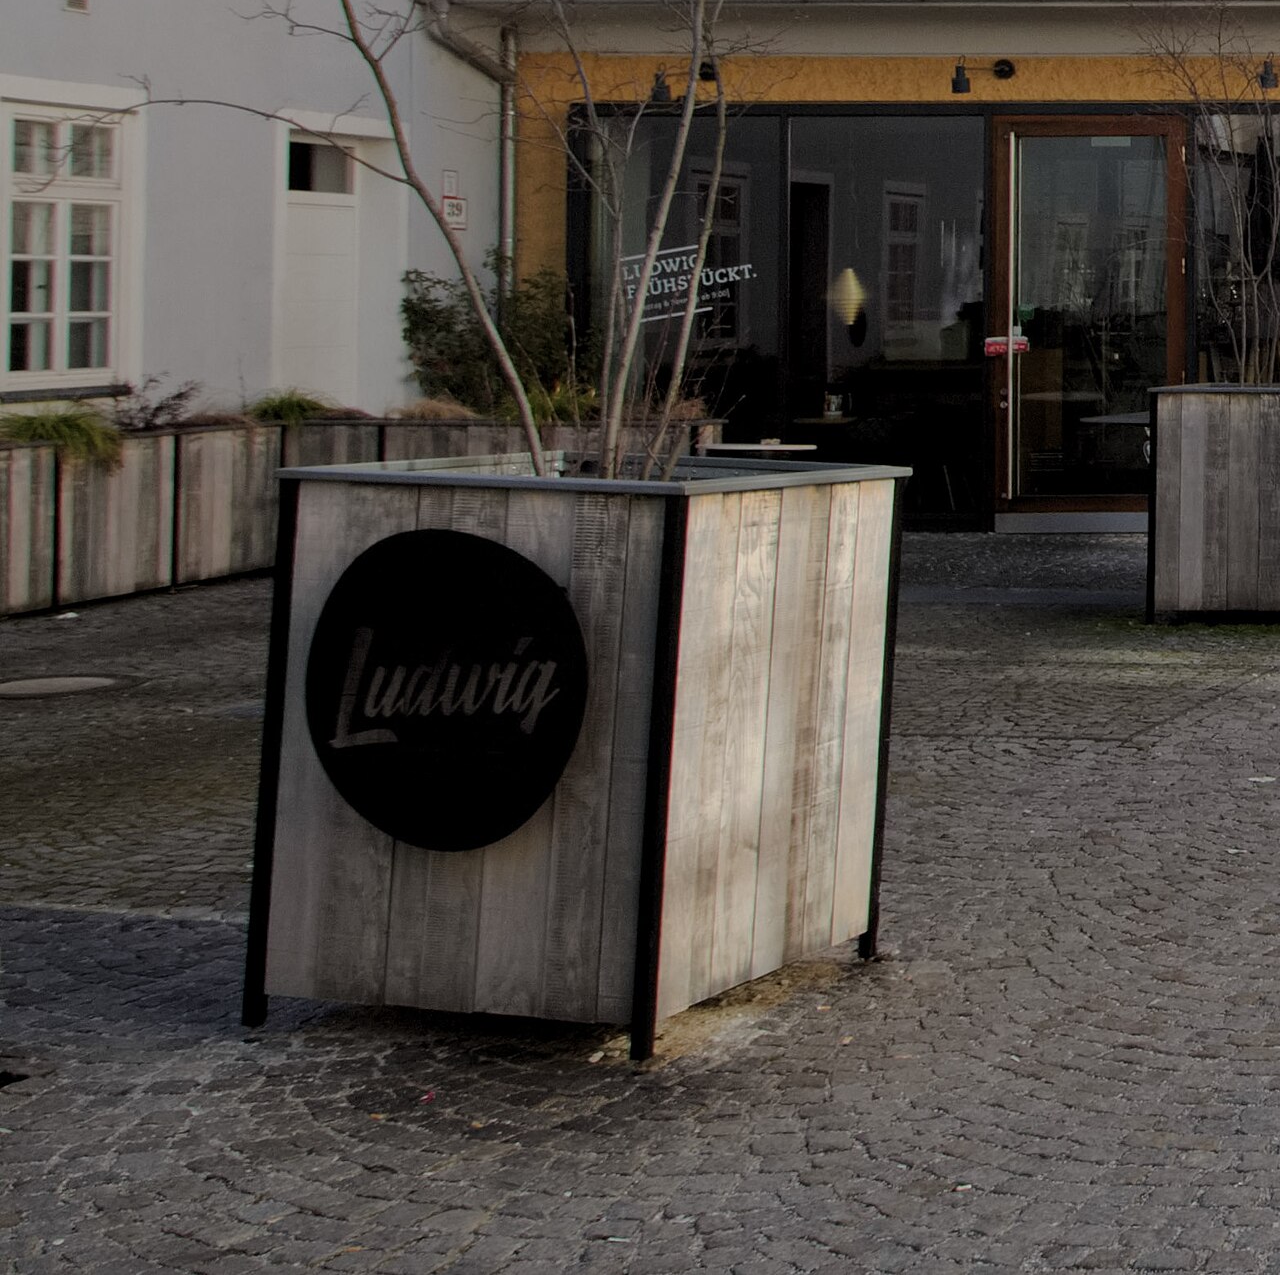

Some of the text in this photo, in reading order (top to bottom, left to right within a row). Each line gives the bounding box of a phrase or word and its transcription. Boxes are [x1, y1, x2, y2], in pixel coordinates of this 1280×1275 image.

[446, 201, 463, 217] 39
[626, 264, 758, 299] FÜHSÜCKT.
[328, 626, 560, 748] Ludwig
